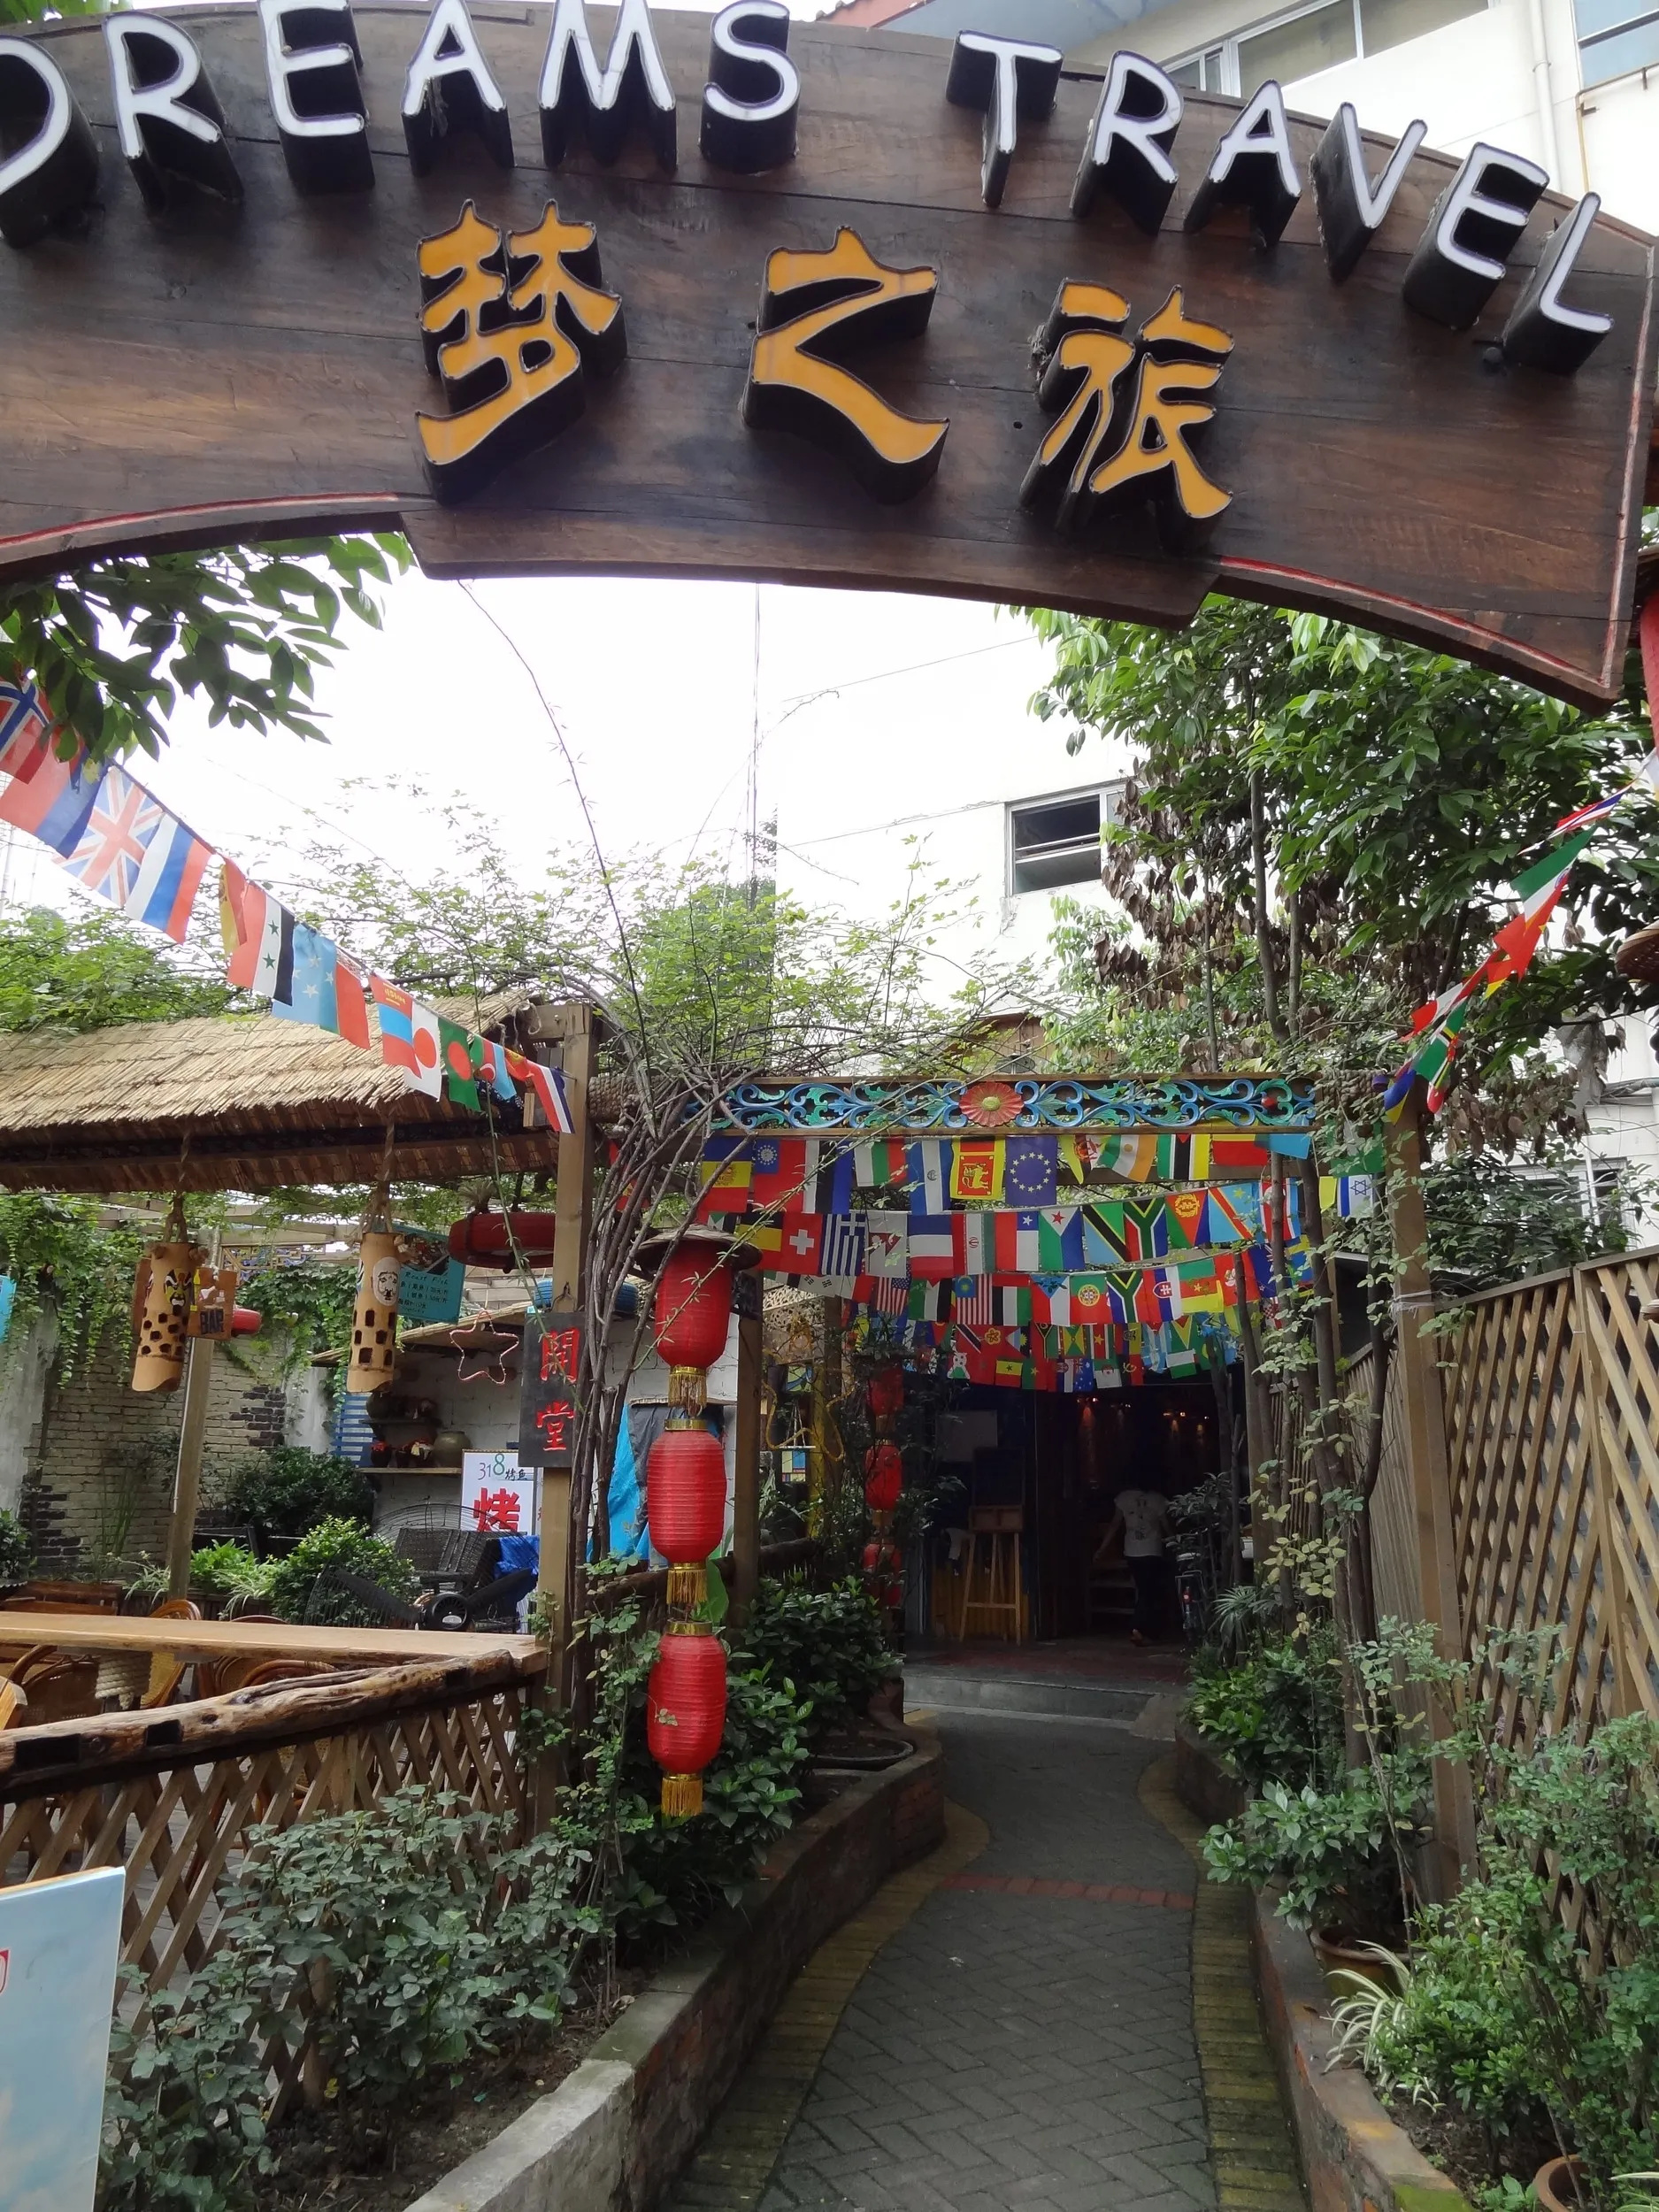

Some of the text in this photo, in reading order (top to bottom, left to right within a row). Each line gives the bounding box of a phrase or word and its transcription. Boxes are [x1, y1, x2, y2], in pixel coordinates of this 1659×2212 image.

[956, 28, 1615, 334] TRAVEL
[414, 198, 1234, 519] 梦之旅
[473, 1487, 520, 1532] 烤
[478, 1453, 505, 1480] 318
